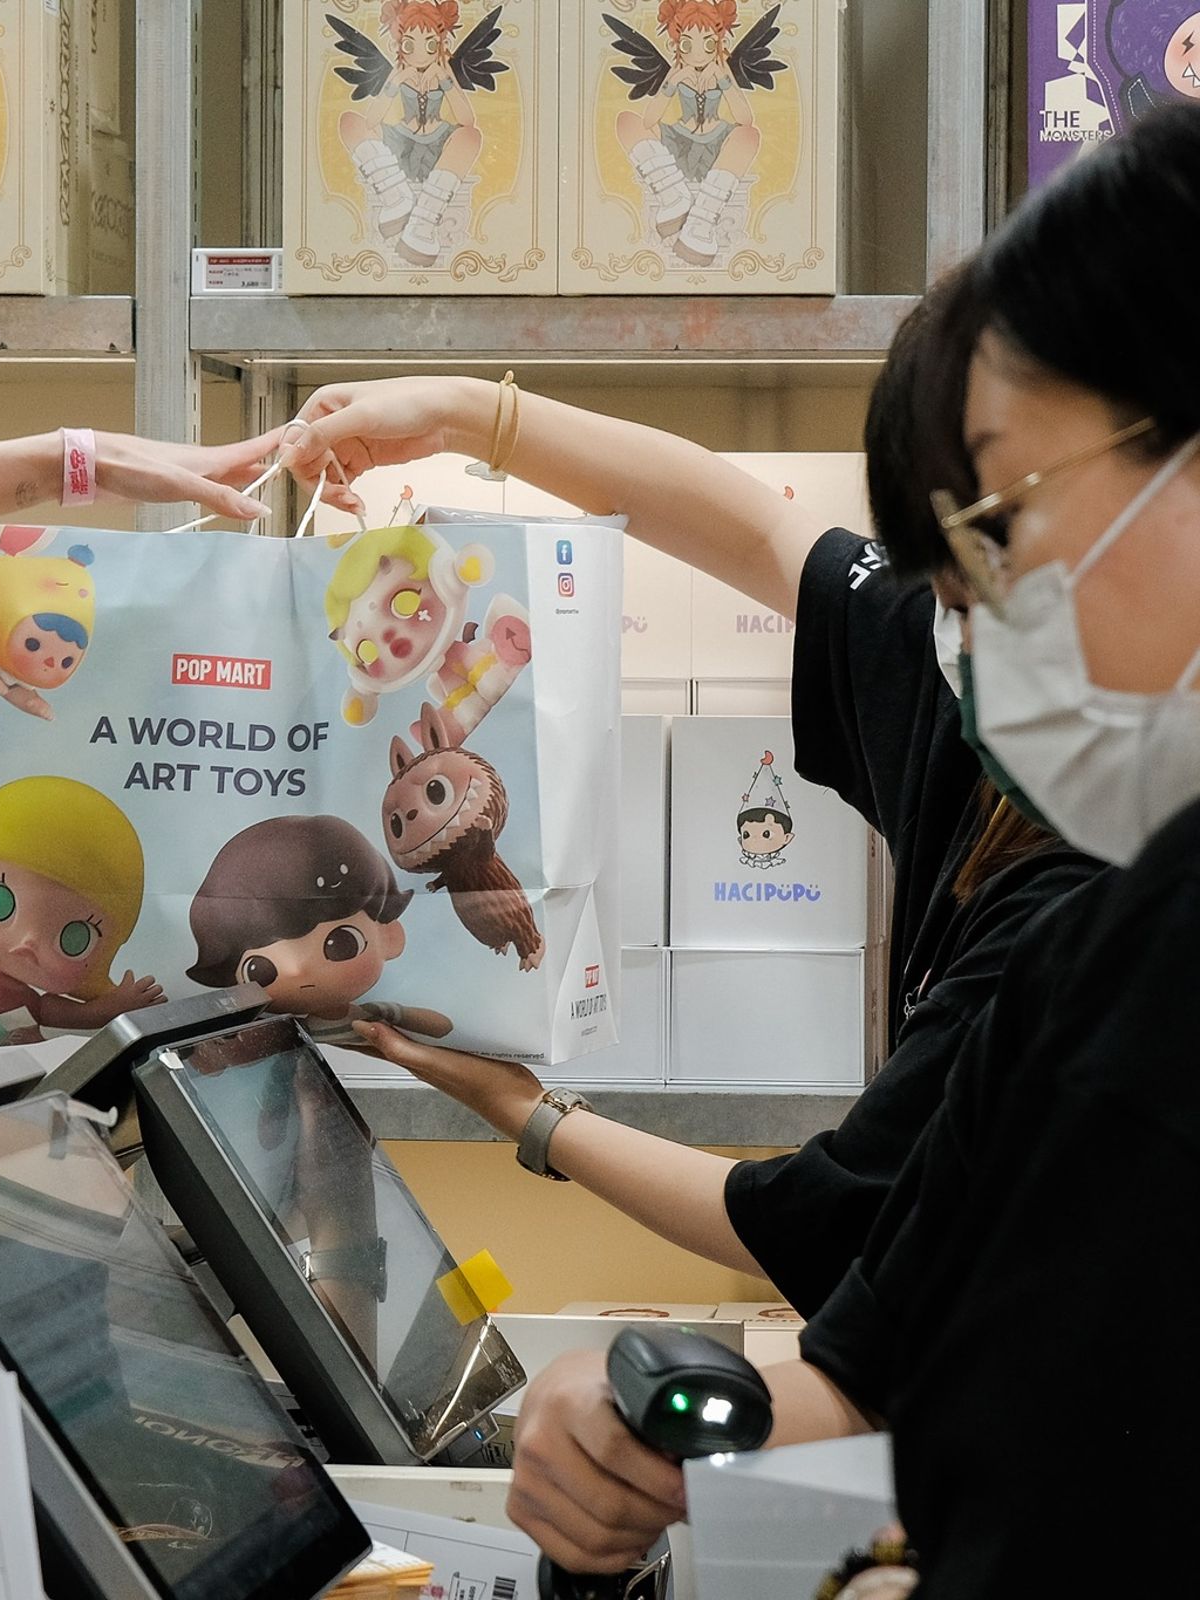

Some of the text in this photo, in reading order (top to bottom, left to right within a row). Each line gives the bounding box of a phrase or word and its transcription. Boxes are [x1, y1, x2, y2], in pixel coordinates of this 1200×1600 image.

[1039, 110, 1080, 128] THE
[1039, 129, 1112, 142] MONSTERS
[736, 614, 796, 634] HACIP
[176, 658, 266, 685] POP MART
[89, 716, 329, 752] A WORLD OF
[123, 762, 306, 796] ART TOYS
